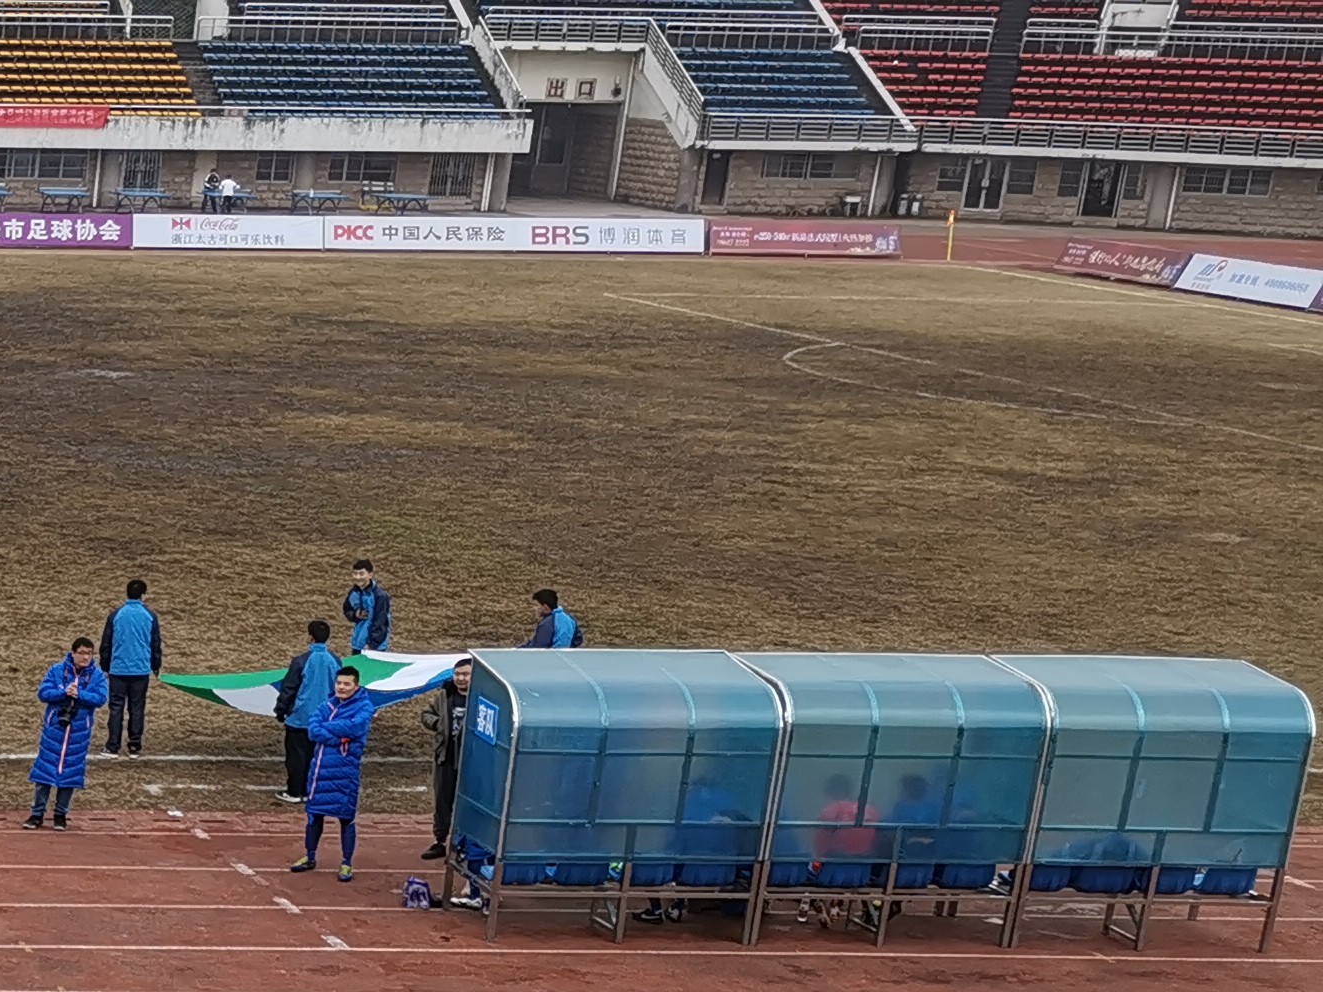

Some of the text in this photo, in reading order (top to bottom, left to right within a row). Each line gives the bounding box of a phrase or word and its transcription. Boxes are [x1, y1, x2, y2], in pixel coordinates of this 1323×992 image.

[547, 78, 594, 98] 出口
[171, 232, 285, 247] 浙江太古可口可乐饮料
[333, 224, 374, 241] PICC
[382, 224, 506, 242] 中国人民保险
[531, 225, 589, 245] BRS
[476, 704, 495, 738] 客队
